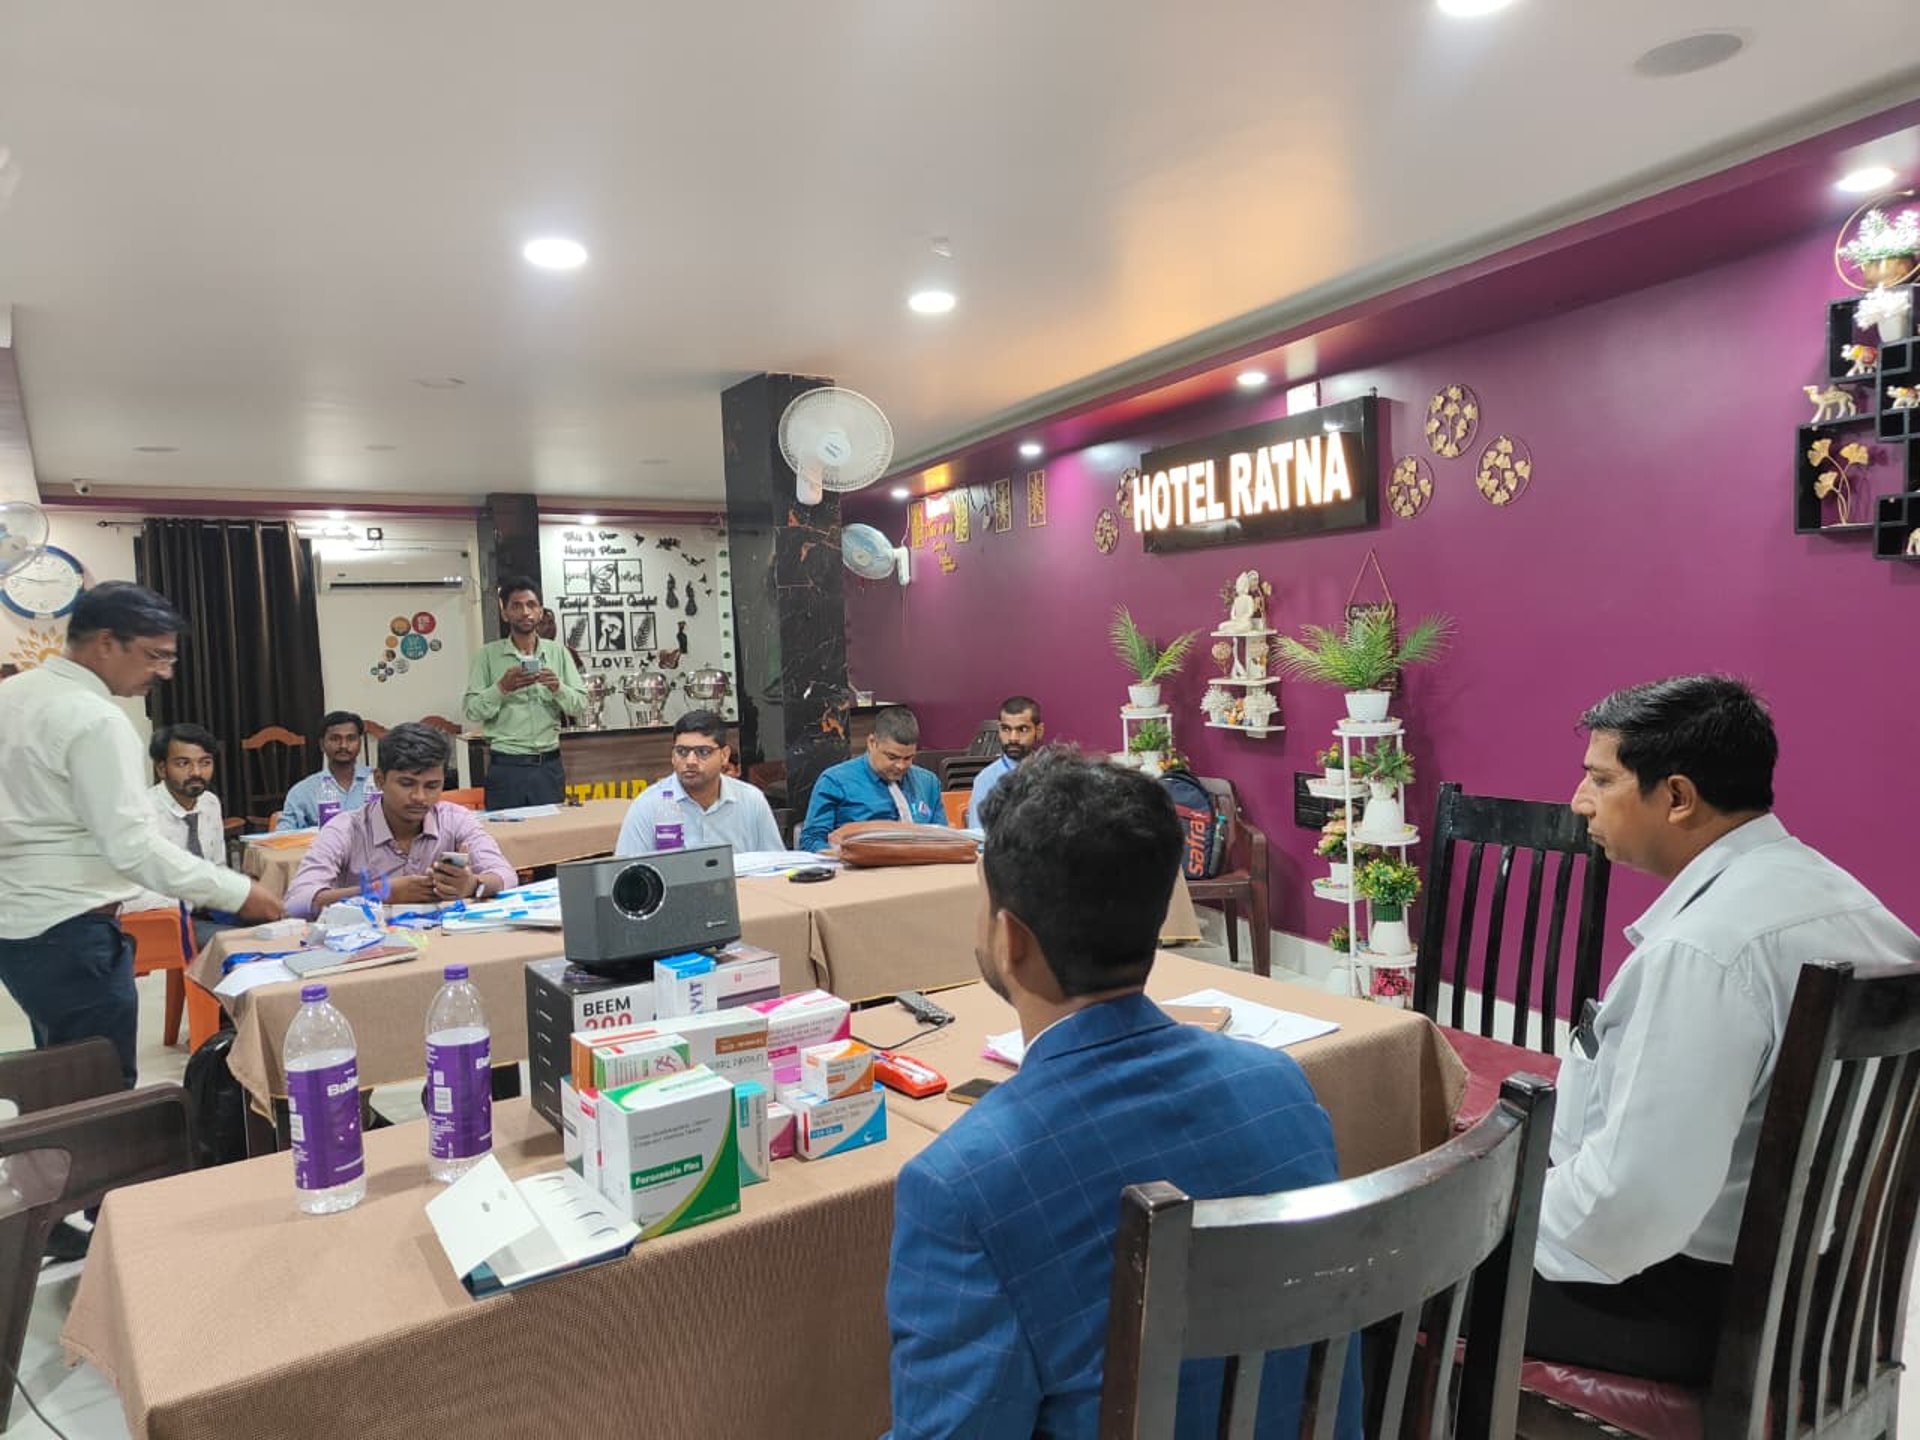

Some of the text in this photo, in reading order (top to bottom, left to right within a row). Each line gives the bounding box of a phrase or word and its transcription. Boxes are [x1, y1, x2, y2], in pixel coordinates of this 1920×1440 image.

[1133, 431, 1352, 532] HOTEL RATNA
[592, 656, 634, 669] LOVE
[582, 995, 632, 1017] BEEM
